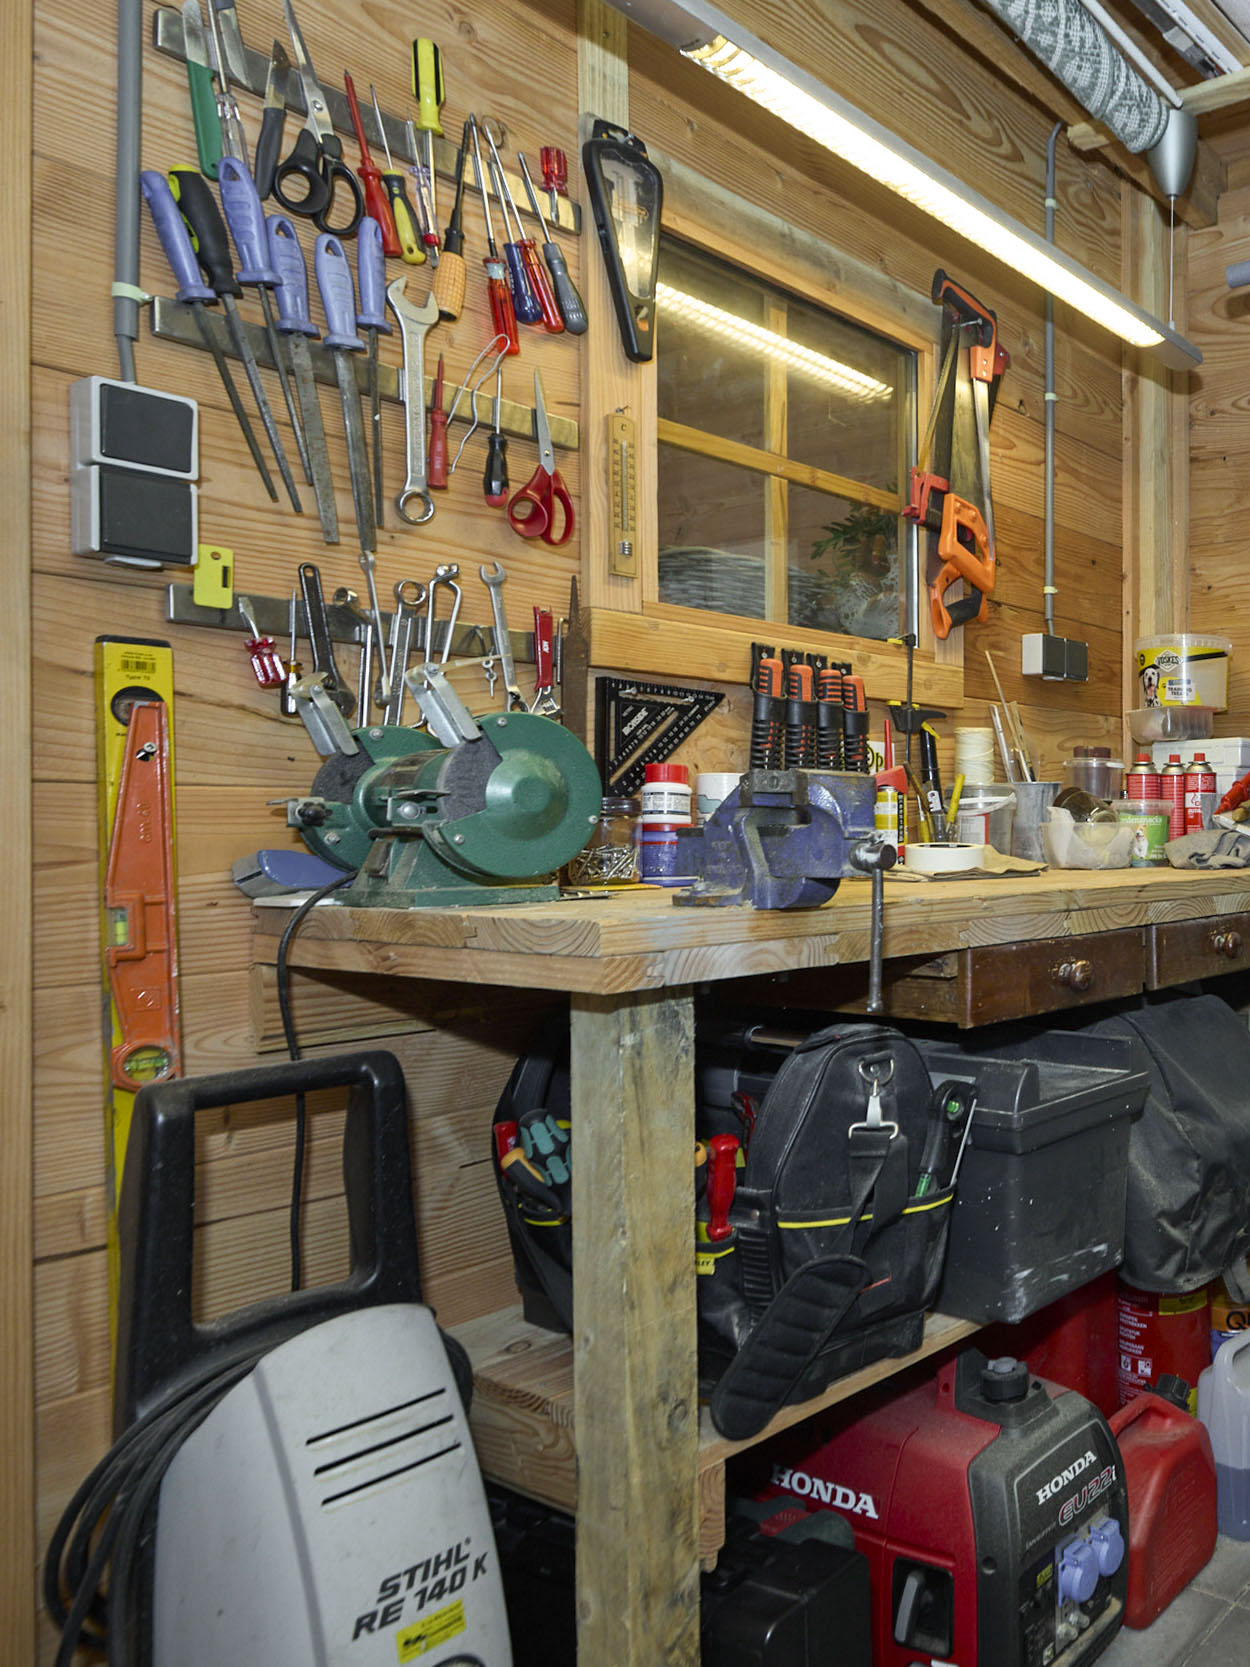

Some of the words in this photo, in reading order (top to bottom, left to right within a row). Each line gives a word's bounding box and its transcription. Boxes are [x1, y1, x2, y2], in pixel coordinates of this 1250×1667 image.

[771, 1464, 879, 1520] HONDA
[1036, 1451, 1097, 1506] HONDA
[1059, 1464, 1116, 1526] EU22i
[352, 1596, 406, 1641] RE
[413, 1565, 468, 1611] 140
[472, 1551, 488, 1582] K
[377, 1542, 470, 1603] STIHL
